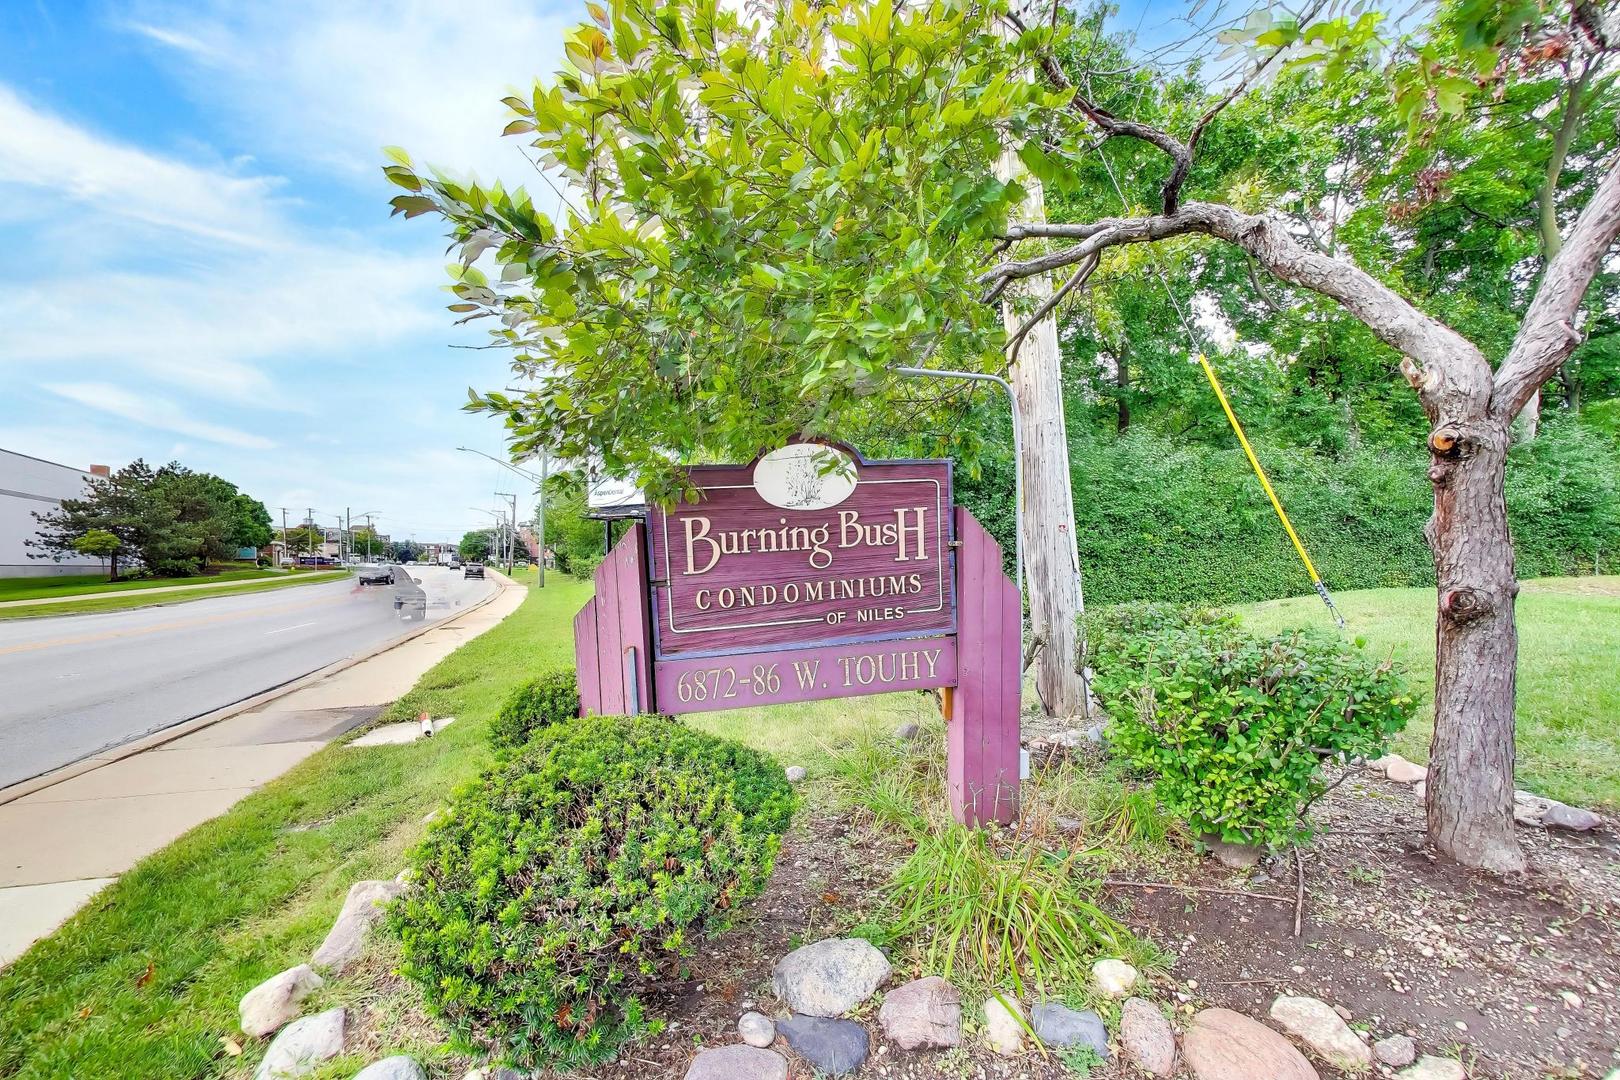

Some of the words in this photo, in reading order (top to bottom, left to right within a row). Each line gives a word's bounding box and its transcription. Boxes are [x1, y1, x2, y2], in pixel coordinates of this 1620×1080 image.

[680, 516, 832, 574] Burning
[695, 573, 922, 610] CONDOMINIUMS
[826, 611, 847, 626] OF
[856, 606, 905, 622] NILES
[677, 663, 781, 703] 6872-86
[791, 660, 828, 691] W.
[837, 649, 942, 686] TOUHY
